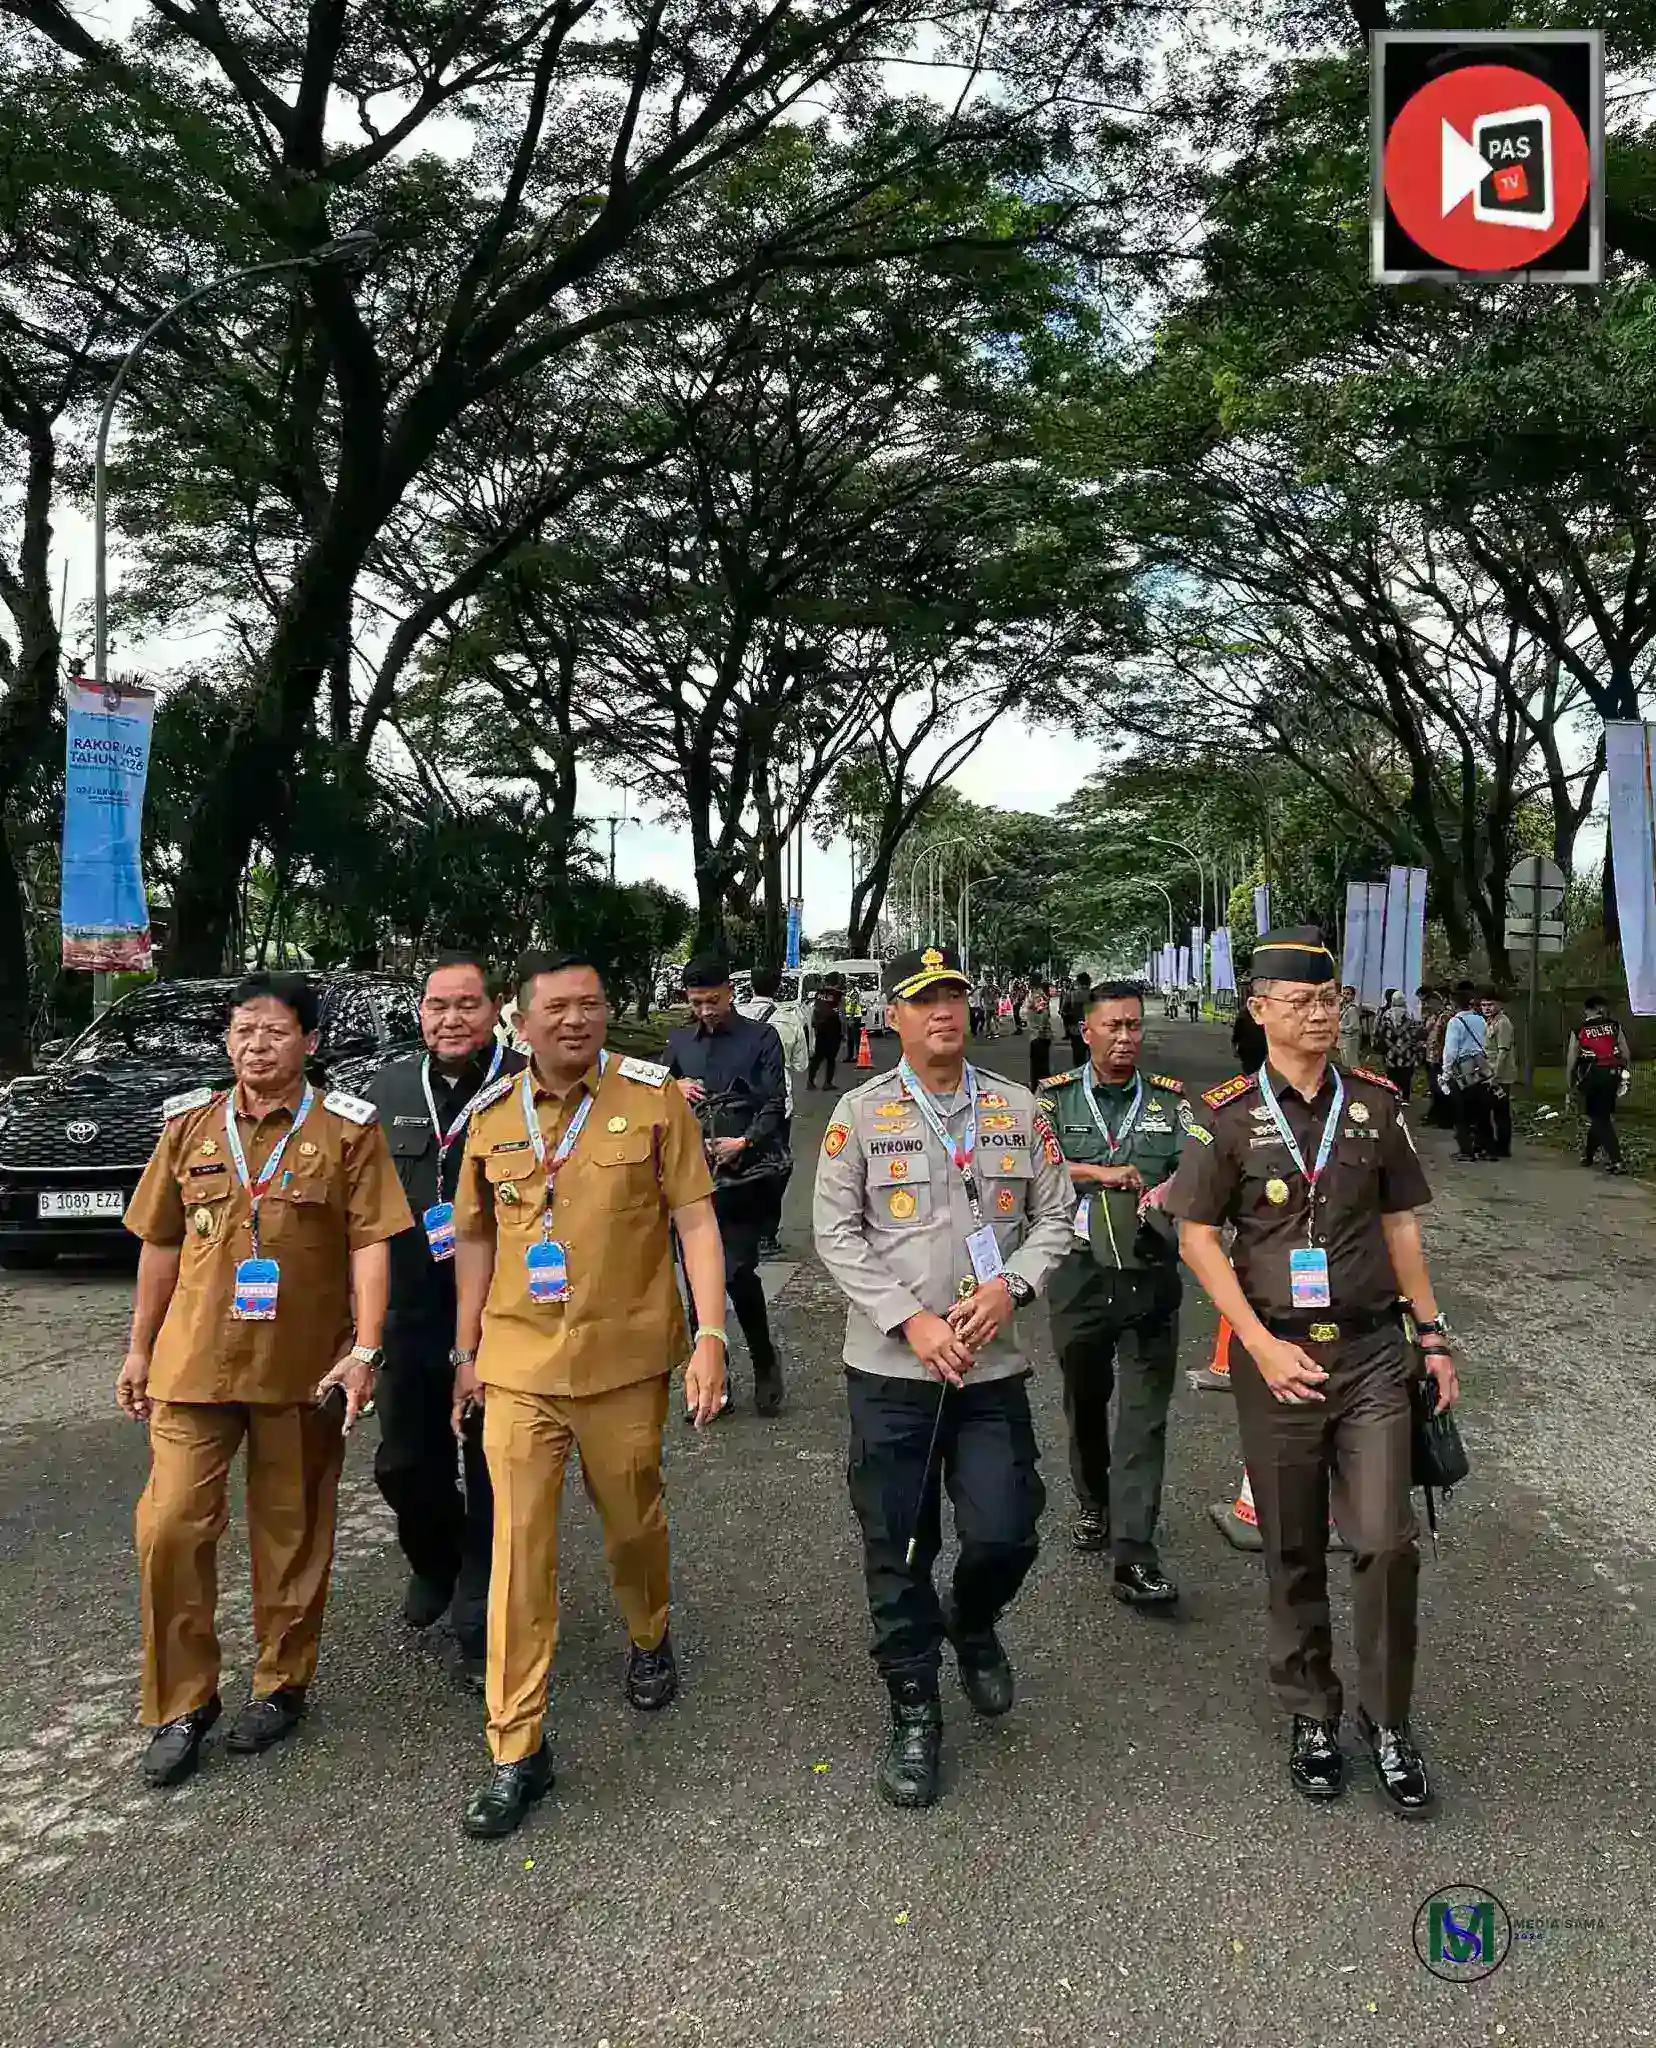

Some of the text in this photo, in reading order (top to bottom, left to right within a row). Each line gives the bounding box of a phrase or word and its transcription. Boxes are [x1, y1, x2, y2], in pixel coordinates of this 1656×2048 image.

[70, 751, 117, 766] TAHUN
[1585, 1025, 1614, 1039] POLISI
[870, 1138, 924, 1155] HYROWO
[980, 1133, 1027, 1148] POLRI
[41, 1193, 120, 1210] B 1089 EZZ
